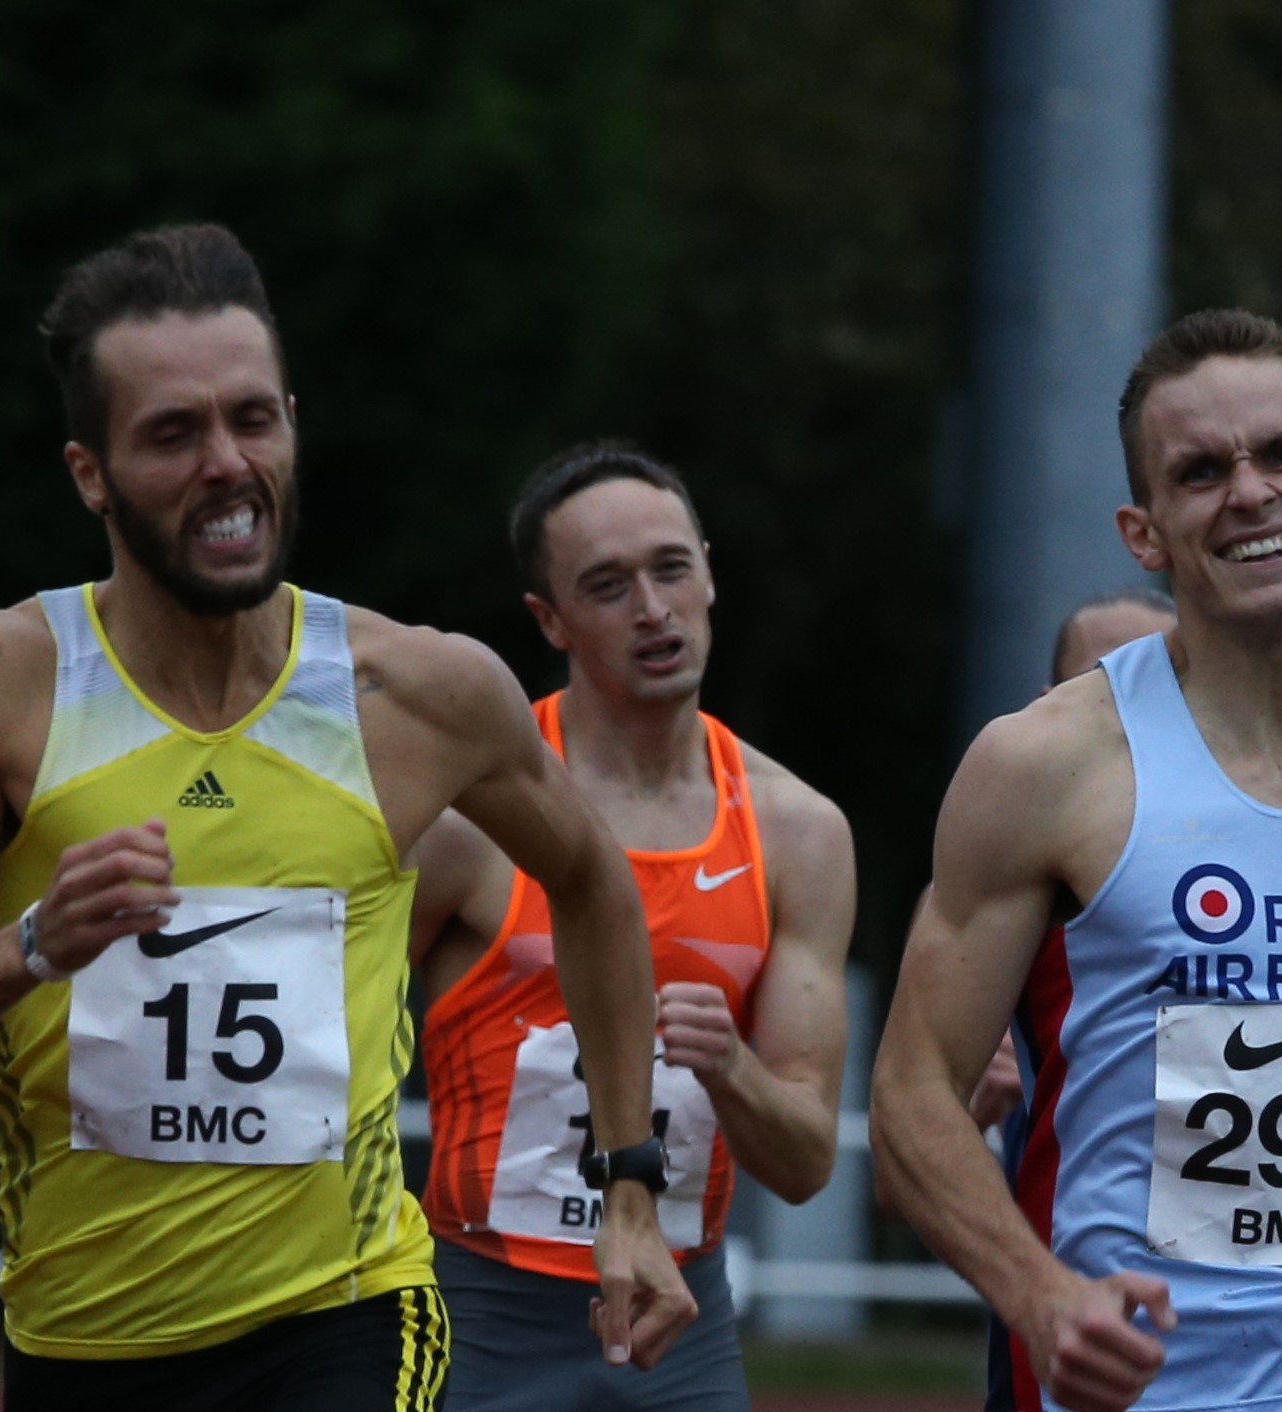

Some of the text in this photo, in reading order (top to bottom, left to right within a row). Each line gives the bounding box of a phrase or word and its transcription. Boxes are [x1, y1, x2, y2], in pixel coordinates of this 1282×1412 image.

[178, 793, 235, 809] adidas
[1144, 953, 1257, 1001] AIR
[143, 983, 284, 1083] 15
[150, 1104, 266, 1145] BMC
